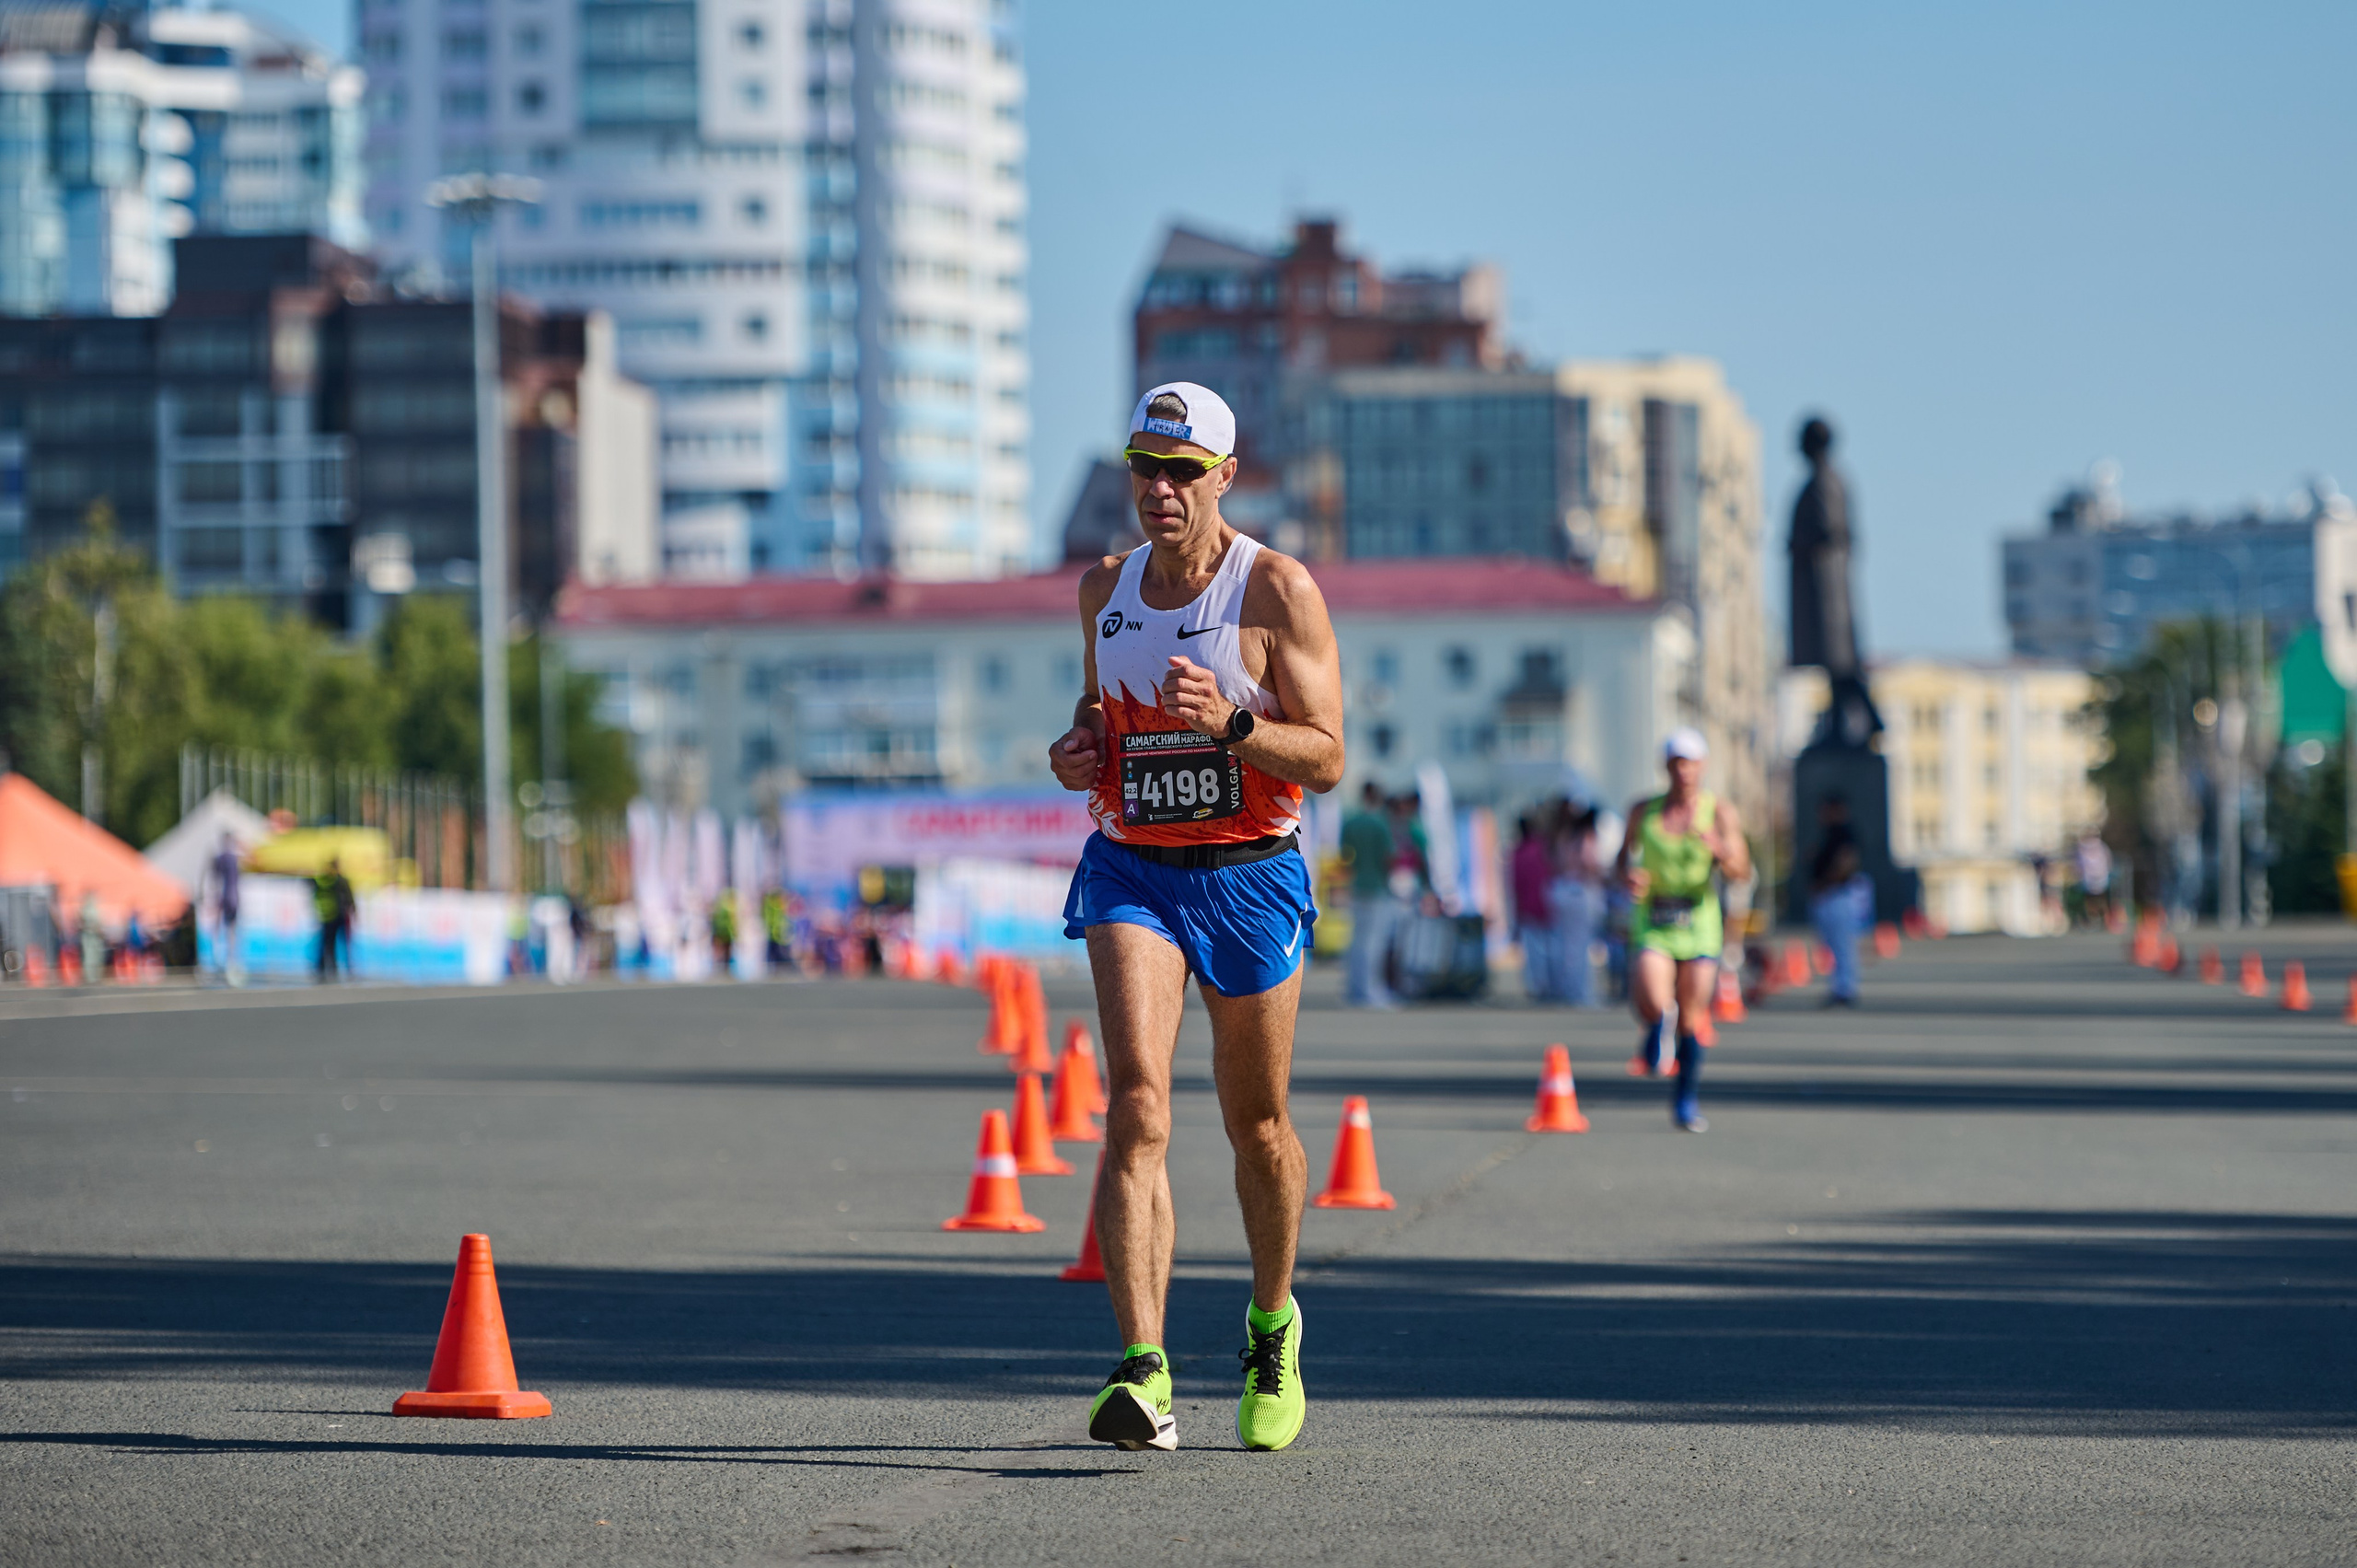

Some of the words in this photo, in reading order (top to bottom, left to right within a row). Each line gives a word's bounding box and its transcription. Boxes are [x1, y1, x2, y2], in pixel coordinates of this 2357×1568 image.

[1125, 621, 1144, 632] NN
[1126, 732, 1180, 748] САМАРСКИЙ
[1181, 735, 1213, 744] МАРАФО
[1142, 768, 1220, 807] 4198
